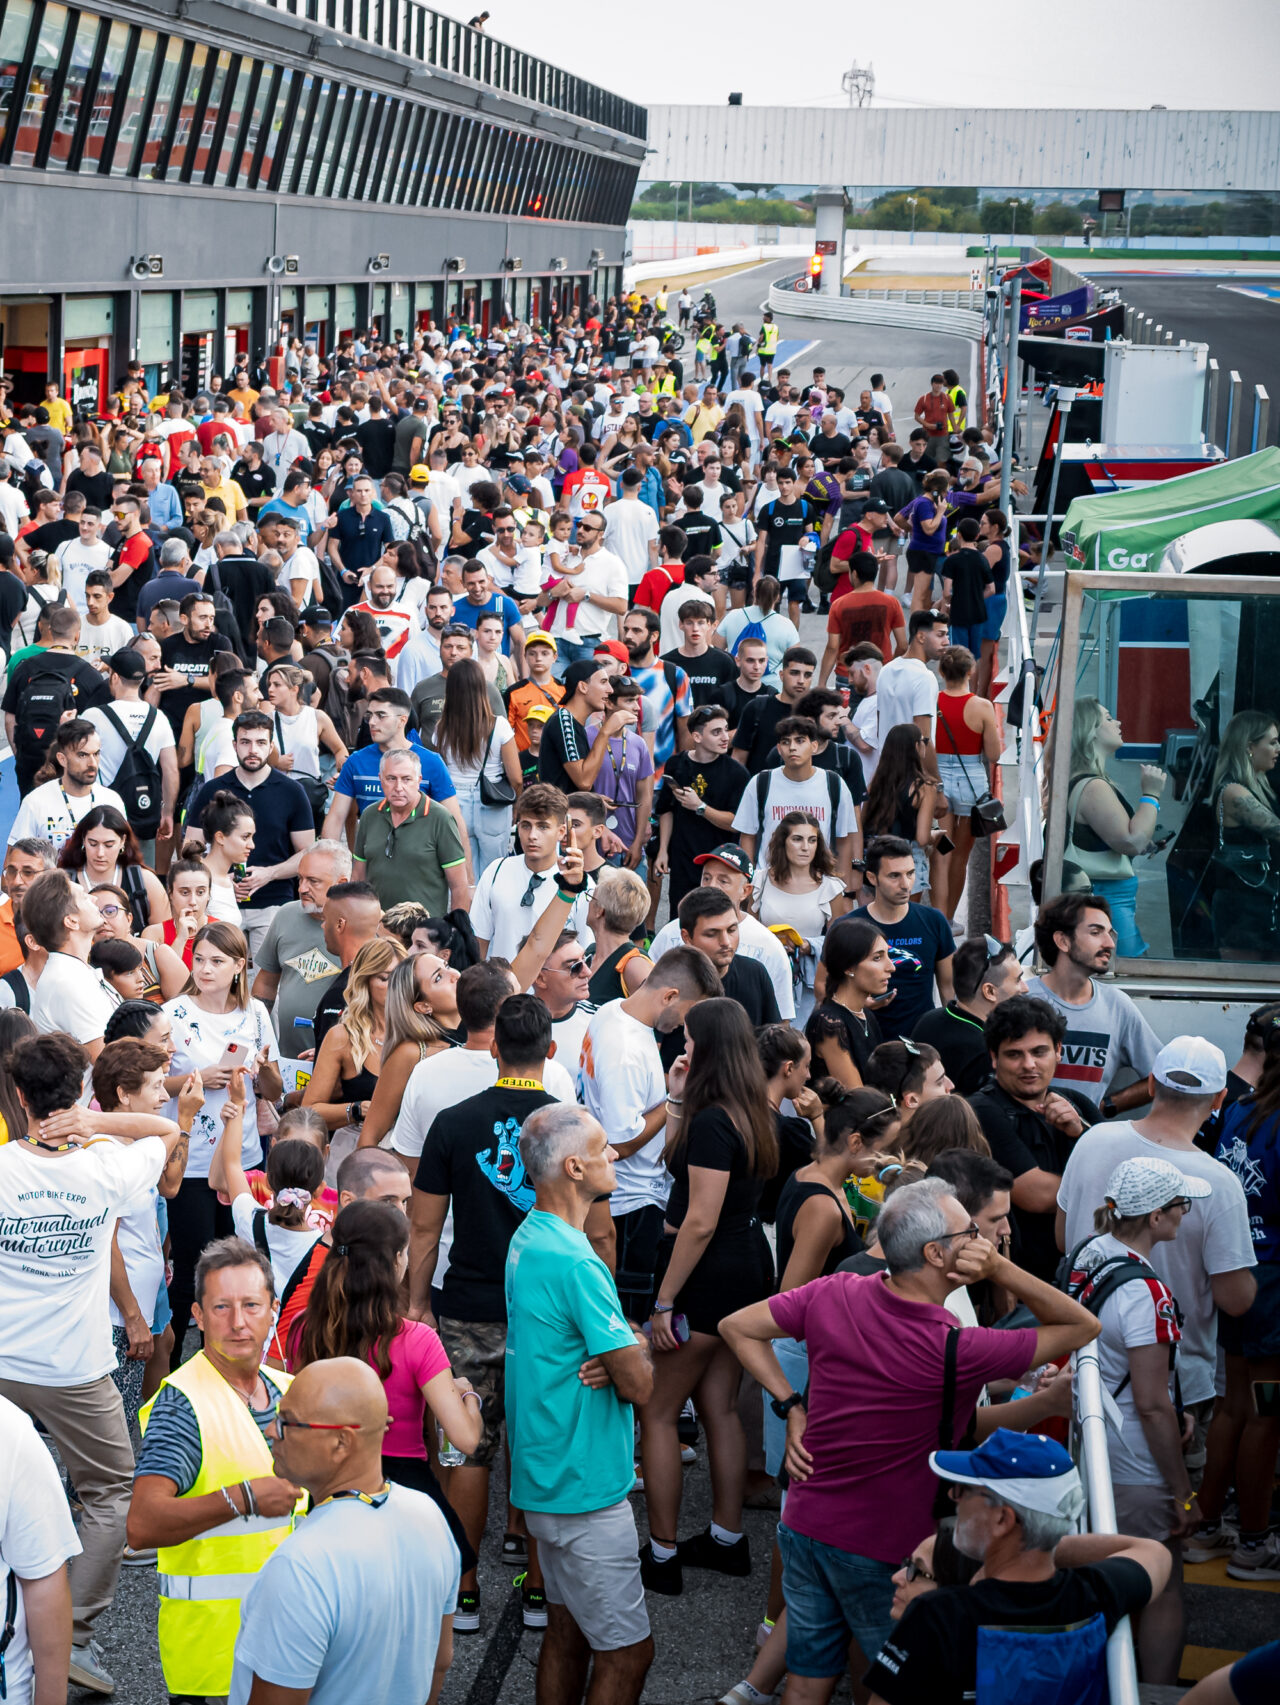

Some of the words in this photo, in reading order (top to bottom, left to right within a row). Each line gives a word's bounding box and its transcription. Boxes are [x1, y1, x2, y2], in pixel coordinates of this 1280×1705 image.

[1107, 547, 1154, 569] Ga
[172, 663, 209, 673] DUCATI
[895, 938, 922, 946] COLORS
[18, 1190, 45, 1203] MOTOR
[46, 1190, 64, 1200] BIKE
[66, 1191, 87, 1204] EXPO
[22, 1264, 50, 1278] VERONA
